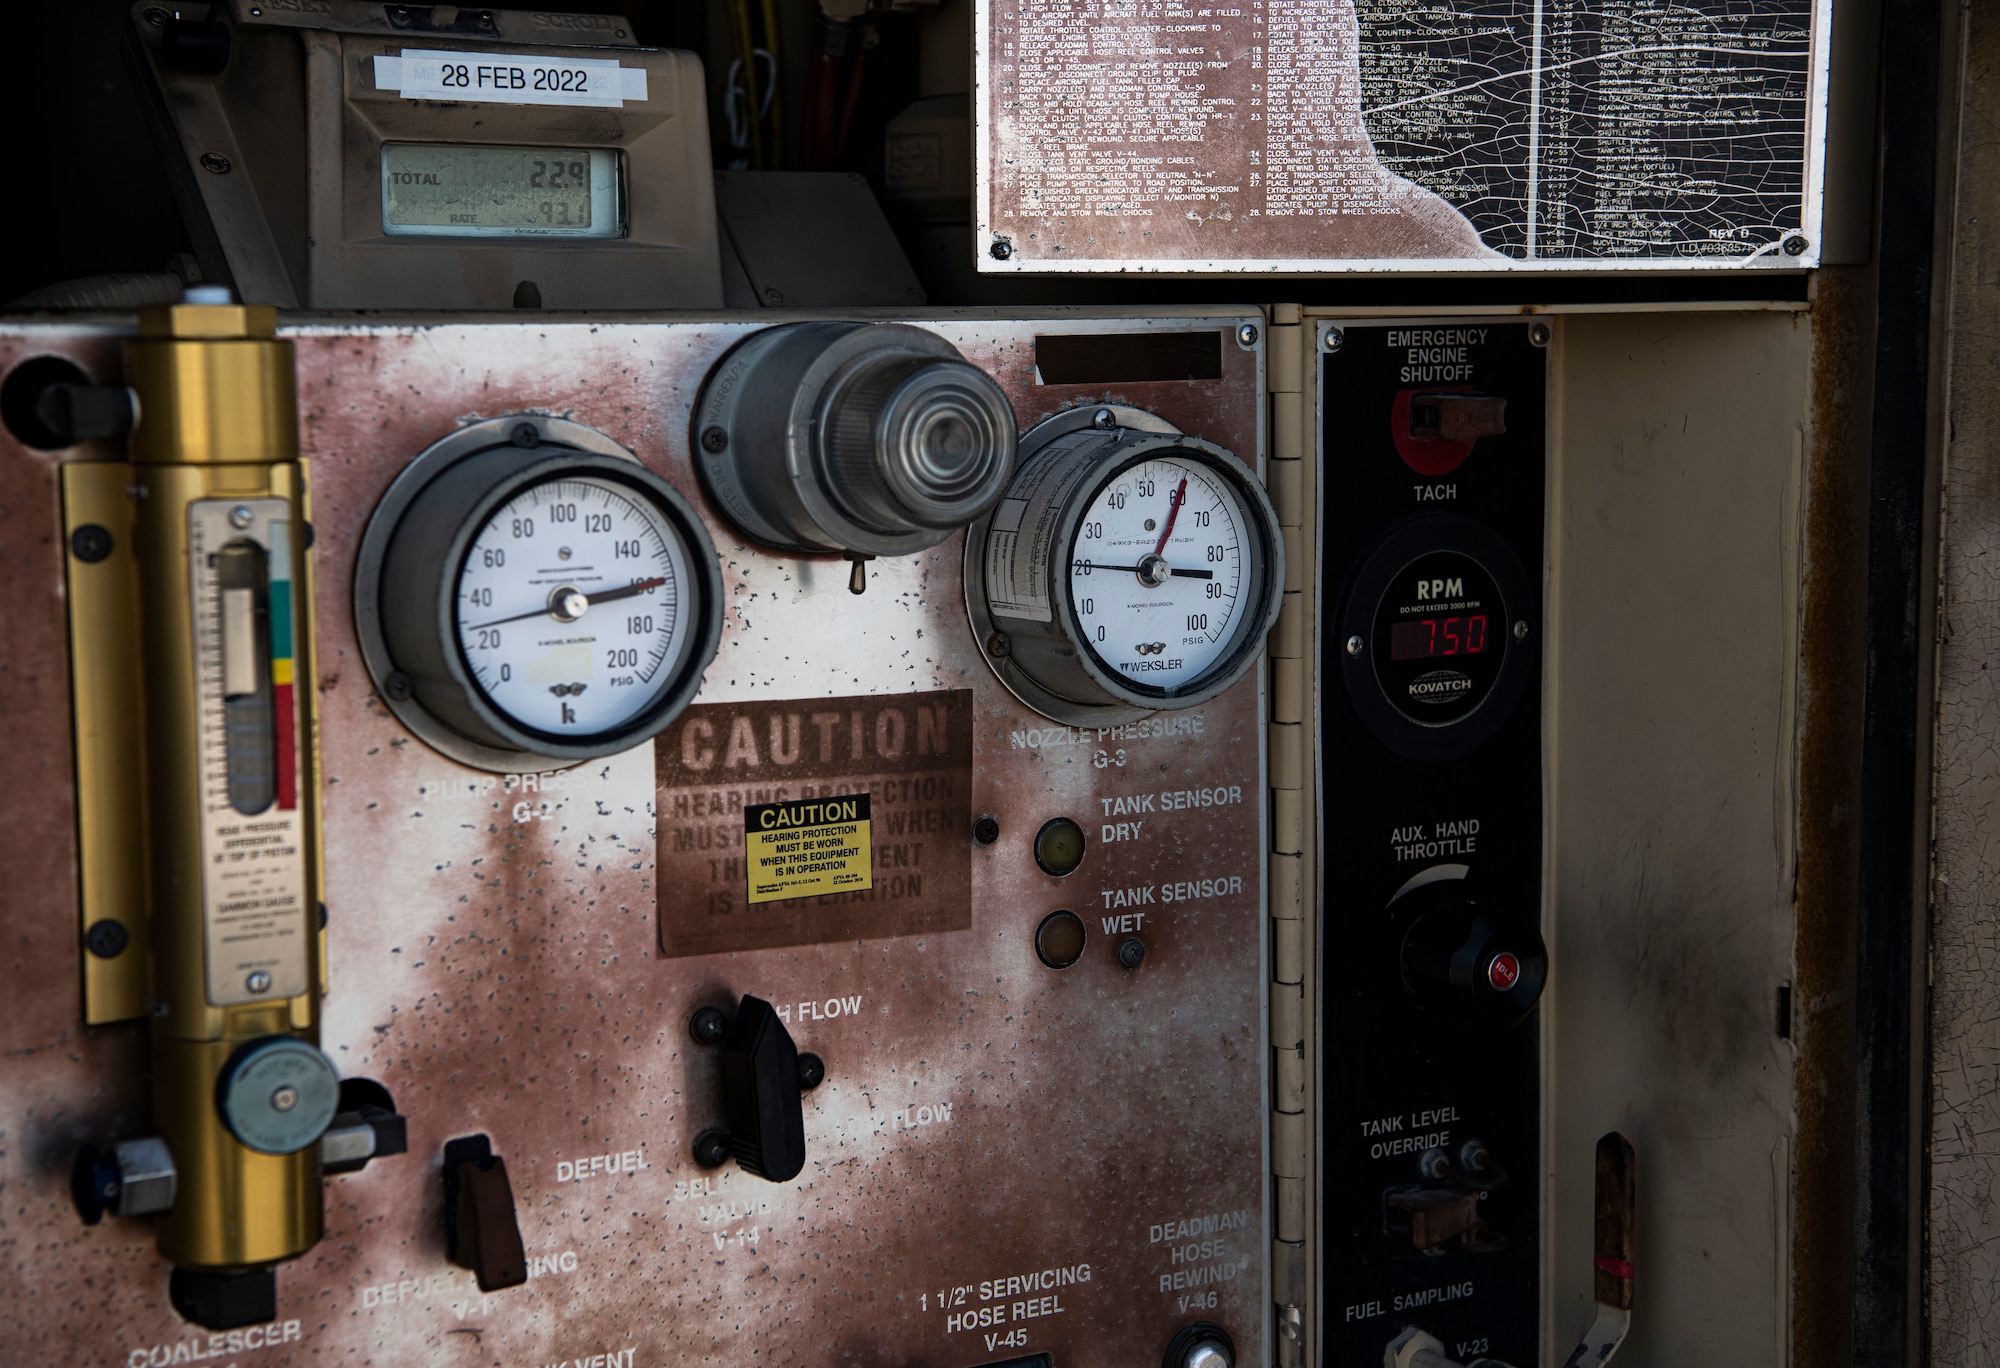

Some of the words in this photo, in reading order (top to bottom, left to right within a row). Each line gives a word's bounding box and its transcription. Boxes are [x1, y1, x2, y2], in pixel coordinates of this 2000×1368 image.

[1141, 10, 1159, 18] FUEL
[1164, 10, 1194, 19] TANK(S)
[1198, 9, 1212, 17] ARE
[1216, 8, 1241, 17] FILLED
[1020, 27, 1046, 35] ROTATE
[1127, 24, 1207, 33] COUNTER-CLOCKWISE
[1211, 24, 1221, 32] TO
[441, 64, 469, 88] 28
[477, 66, 526, 89] FEB
[533, 68, 588, 92] 2022
[391, 172, 442, 186] TOTAL
[1019, 180, 1042, 188] PLACE
[450, 213, 478, 224] RATE
[1265, 208, 1295, 216] REMOVE
[1318, 208, 1338, 216] STOW
[1709, 229, 1735, 239] REV
[1387, 329, 1488, 347] EMERGENCY
[1407, 347, 1467, 365] ENGINE
[1400, 365, 1474, 383] SHUTOFF
[1138, 480, 1155, 498] 50
[1413, 484, 1457, 501] TACH
[1107, 493, 1125, 510] 40
[550, 503, 577, 523] 100
[1194, 511, 1210, 529] 70
[512, 518, 534, 538] 80
[585, 513, 612, 534] 120
[1085, 523, 1102, 540] 30
[483, 549, 505, 568] 60
[614, 540, 641, 559] 140
[1207, 544, 1224, 563] 80
[1074, 559, 1092, 577] 20
[470, 587, 492, 608] 40
[1206, 582, 1222, 599] 90
[1417, 577, 1464, 601] RPM
[1081, 598, 1094, 615] 10
[1400, 606, 1411, 614] DO
[1411, 605, 1425, 613] NOT
[1426, 603, 1449, 612] EXCEED
[1449, 602, 1466, 610] 2000
[1466, 600, 1481, 608] RPM
[627, 616, 653, 635] 180
[1186, 613, 1208, 631] 100
[478, 629, 501, 650] 20
[1097, 625, 1105, 642] 0
[1182, 637, 1204, 646] PSIG
[1421, 615, 1487, 656] 750
[607, 649, 638, 669] 200
[1130, 659, 1182, 672] WEKSLER
[500, 664, 511, 682] 0
[609, 676, 634, 687] PSIG
[1408, 679, 1472, 695] KOVATCH
[681, 704, 948, 771] CAUTION
[1011, 727, 1092, 750] NOZZLE
[1097, 715, 1204, 742] PRESSURE
[1093, 748, 1127, 769] G-3
[421, 776, 497, 801] PUMP
[1101, 794, 1155, 817] TANK
[1160, 785, 1242, 811] SENSOR
[512, 801, 555, 824] G-2
[760, 800, 857, 829] CAUTION
[761, 831, 800, 844] HEARING
[802, 824, 857, 839] PROTECTION
[1101, 821, 1143, 844] DRY
[1390, 825, 1427, 844] AUX.
[1435, 819, 1480, 839] HAND
[775, 842, 801, 854] MUST
[802, 841, 815, 851] BE
[816, 837, 844, 849] WORN
[1394, 837, 1476, 862] THROTTLE
[760, 856, 786, 867] WHEN
[787, 854, 808, 864] THIS
[810, 847, 859, 862] EQUIPMENT
[775, 867, 784, 877] IS
[785, 866, 795, 876] IN
[796, 860, 846, 874] OPERATION
[1101, 885, 1156, 909] TANK
[1160, 875, 1242, 903] SENSOR
[1101, 912, 1146, 936] WET
[1496, 961, 1515, 981] IDLE
[798, 995, 862, 1022] FLOW
[892, 1102, 953, 1130] FLOW
[1360, 1115, 1404, 1137] TANK
[1411, 1106, 1461, 1129] LEVEL
[1370, 1130, 1450, 1160] OVERRIDE
[556, 1149, 651, 1183] DEFUEL
[699, 1199, 772, 1224] VALVE
[1149, 1209, 1246, 1244] DEADMAN
[712, 1226, 761, 1251] V-14
[1171, 1238, 1226, 1266] HOSE
[919, 1292, 927, 1313] 1
[936, 1284, 975, 1310] 1/2"
[978, 1262, 1092, 1302] SERVICING
[1158, 1261, 1238, 1294] REWIND
[1176, 1289, 1218, 1315] V-46
[1346, 1300, 1386, 1322] FUEL
[1393, 1281, 1474, 1312] SAMPLING
[946, 1306, 1006, 1335] HOSE
[1012, 1294, 1065, 1322] REEL
[127, 1319, 301, 1368] COALESCER
[983, 1327, 1028, 1353] V-45
[1456, 1337, 1489, 1358] V-23
